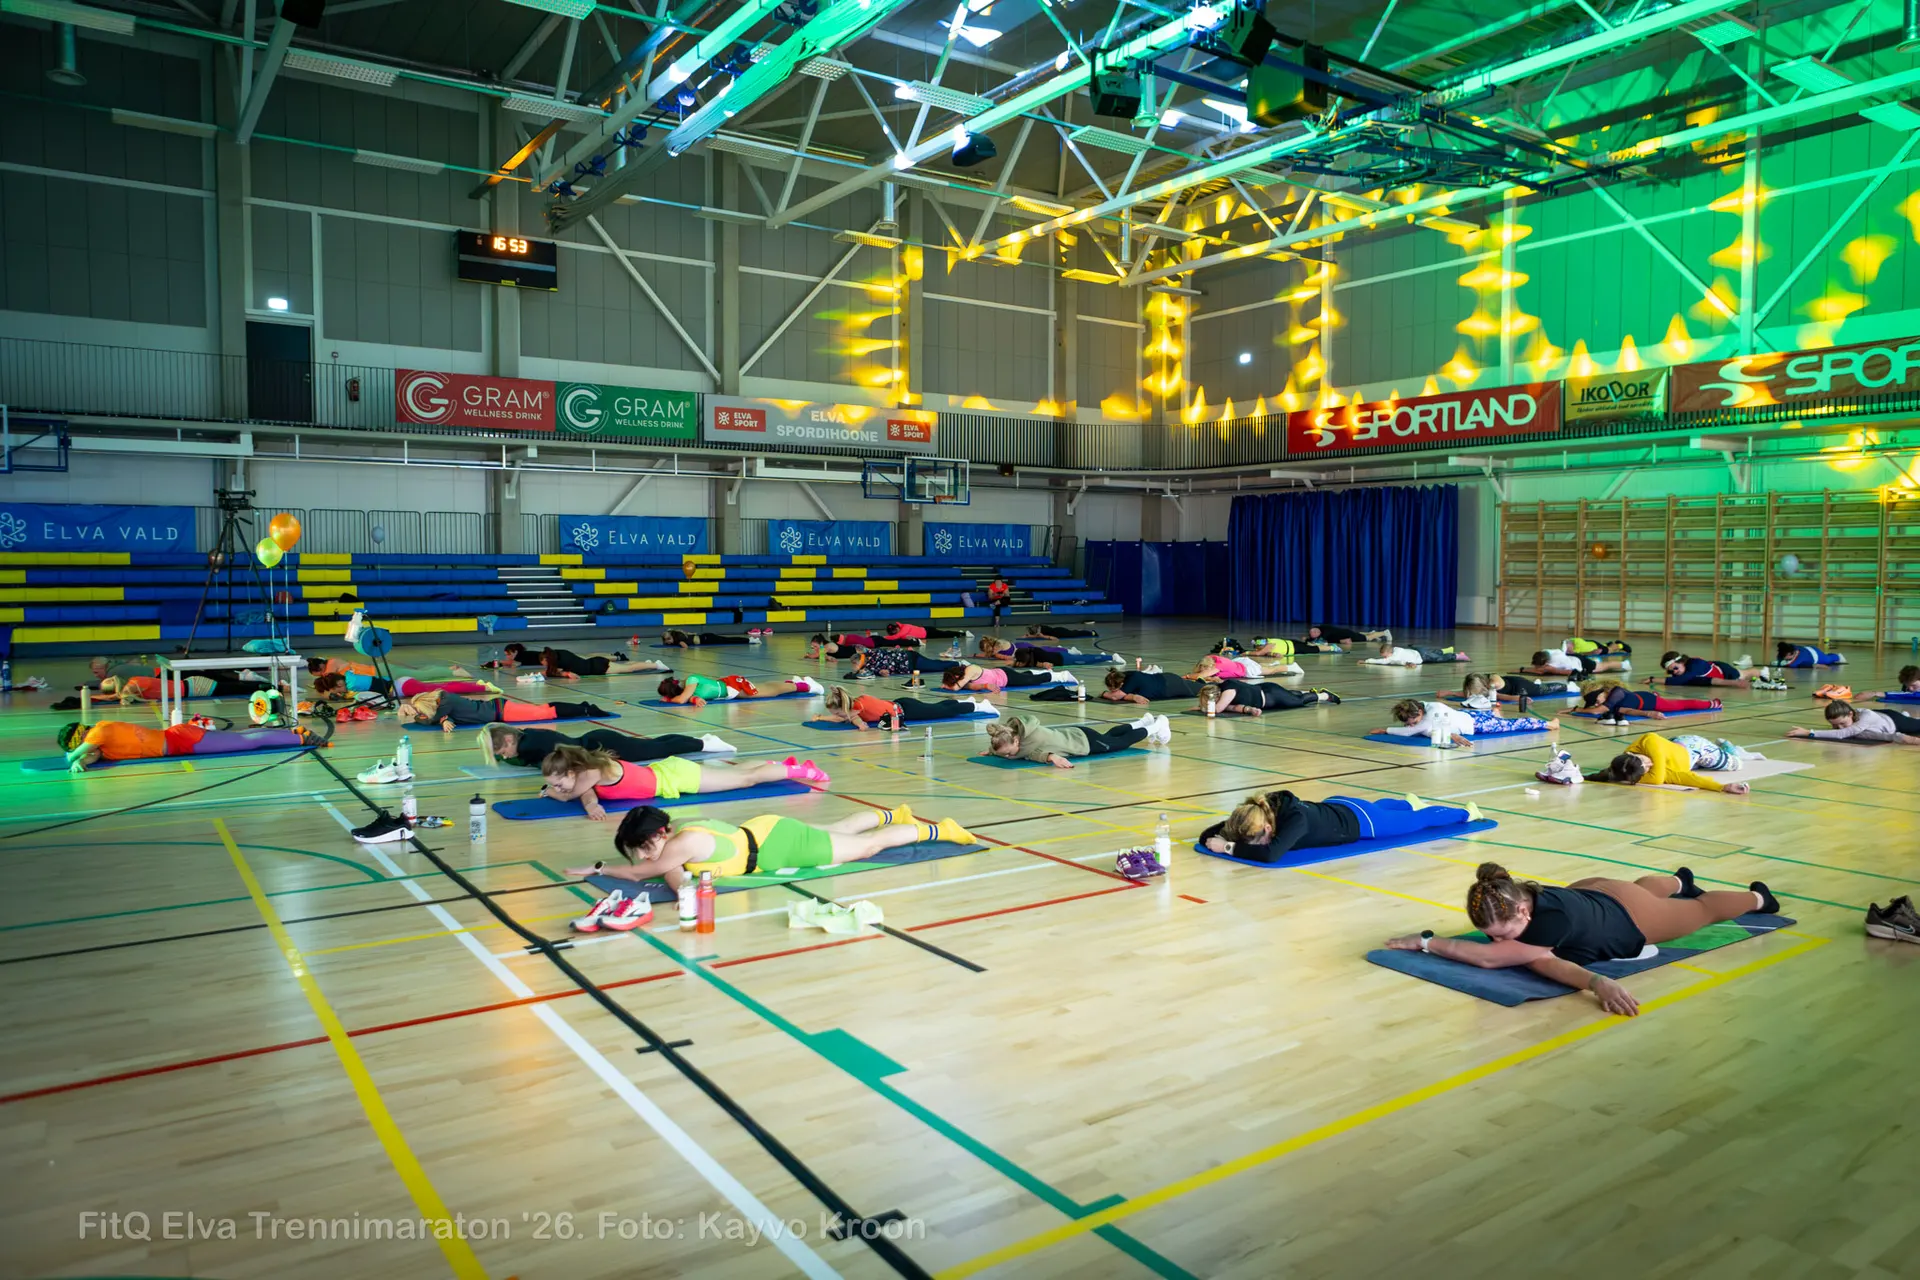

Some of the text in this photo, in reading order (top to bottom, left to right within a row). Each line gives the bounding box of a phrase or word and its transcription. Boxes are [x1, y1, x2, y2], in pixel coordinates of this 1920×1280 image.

[1581, 381, 1649, 402] IKODOR
[463, 408, 542, 420] WELLNESS DRINK
[733, 412, 752, 420] ELVA
[811, 410, 846, 424] ELVA
[1352, 393, 1537, 440] SPORTLAND
[614, 418, 685, 429] WELLNESS DRINK
[903, 424, 919, 432] ELVA
[776, 424, 879, 443] SPORDIHOONE
[903, 431, 924, 439] SPORT
